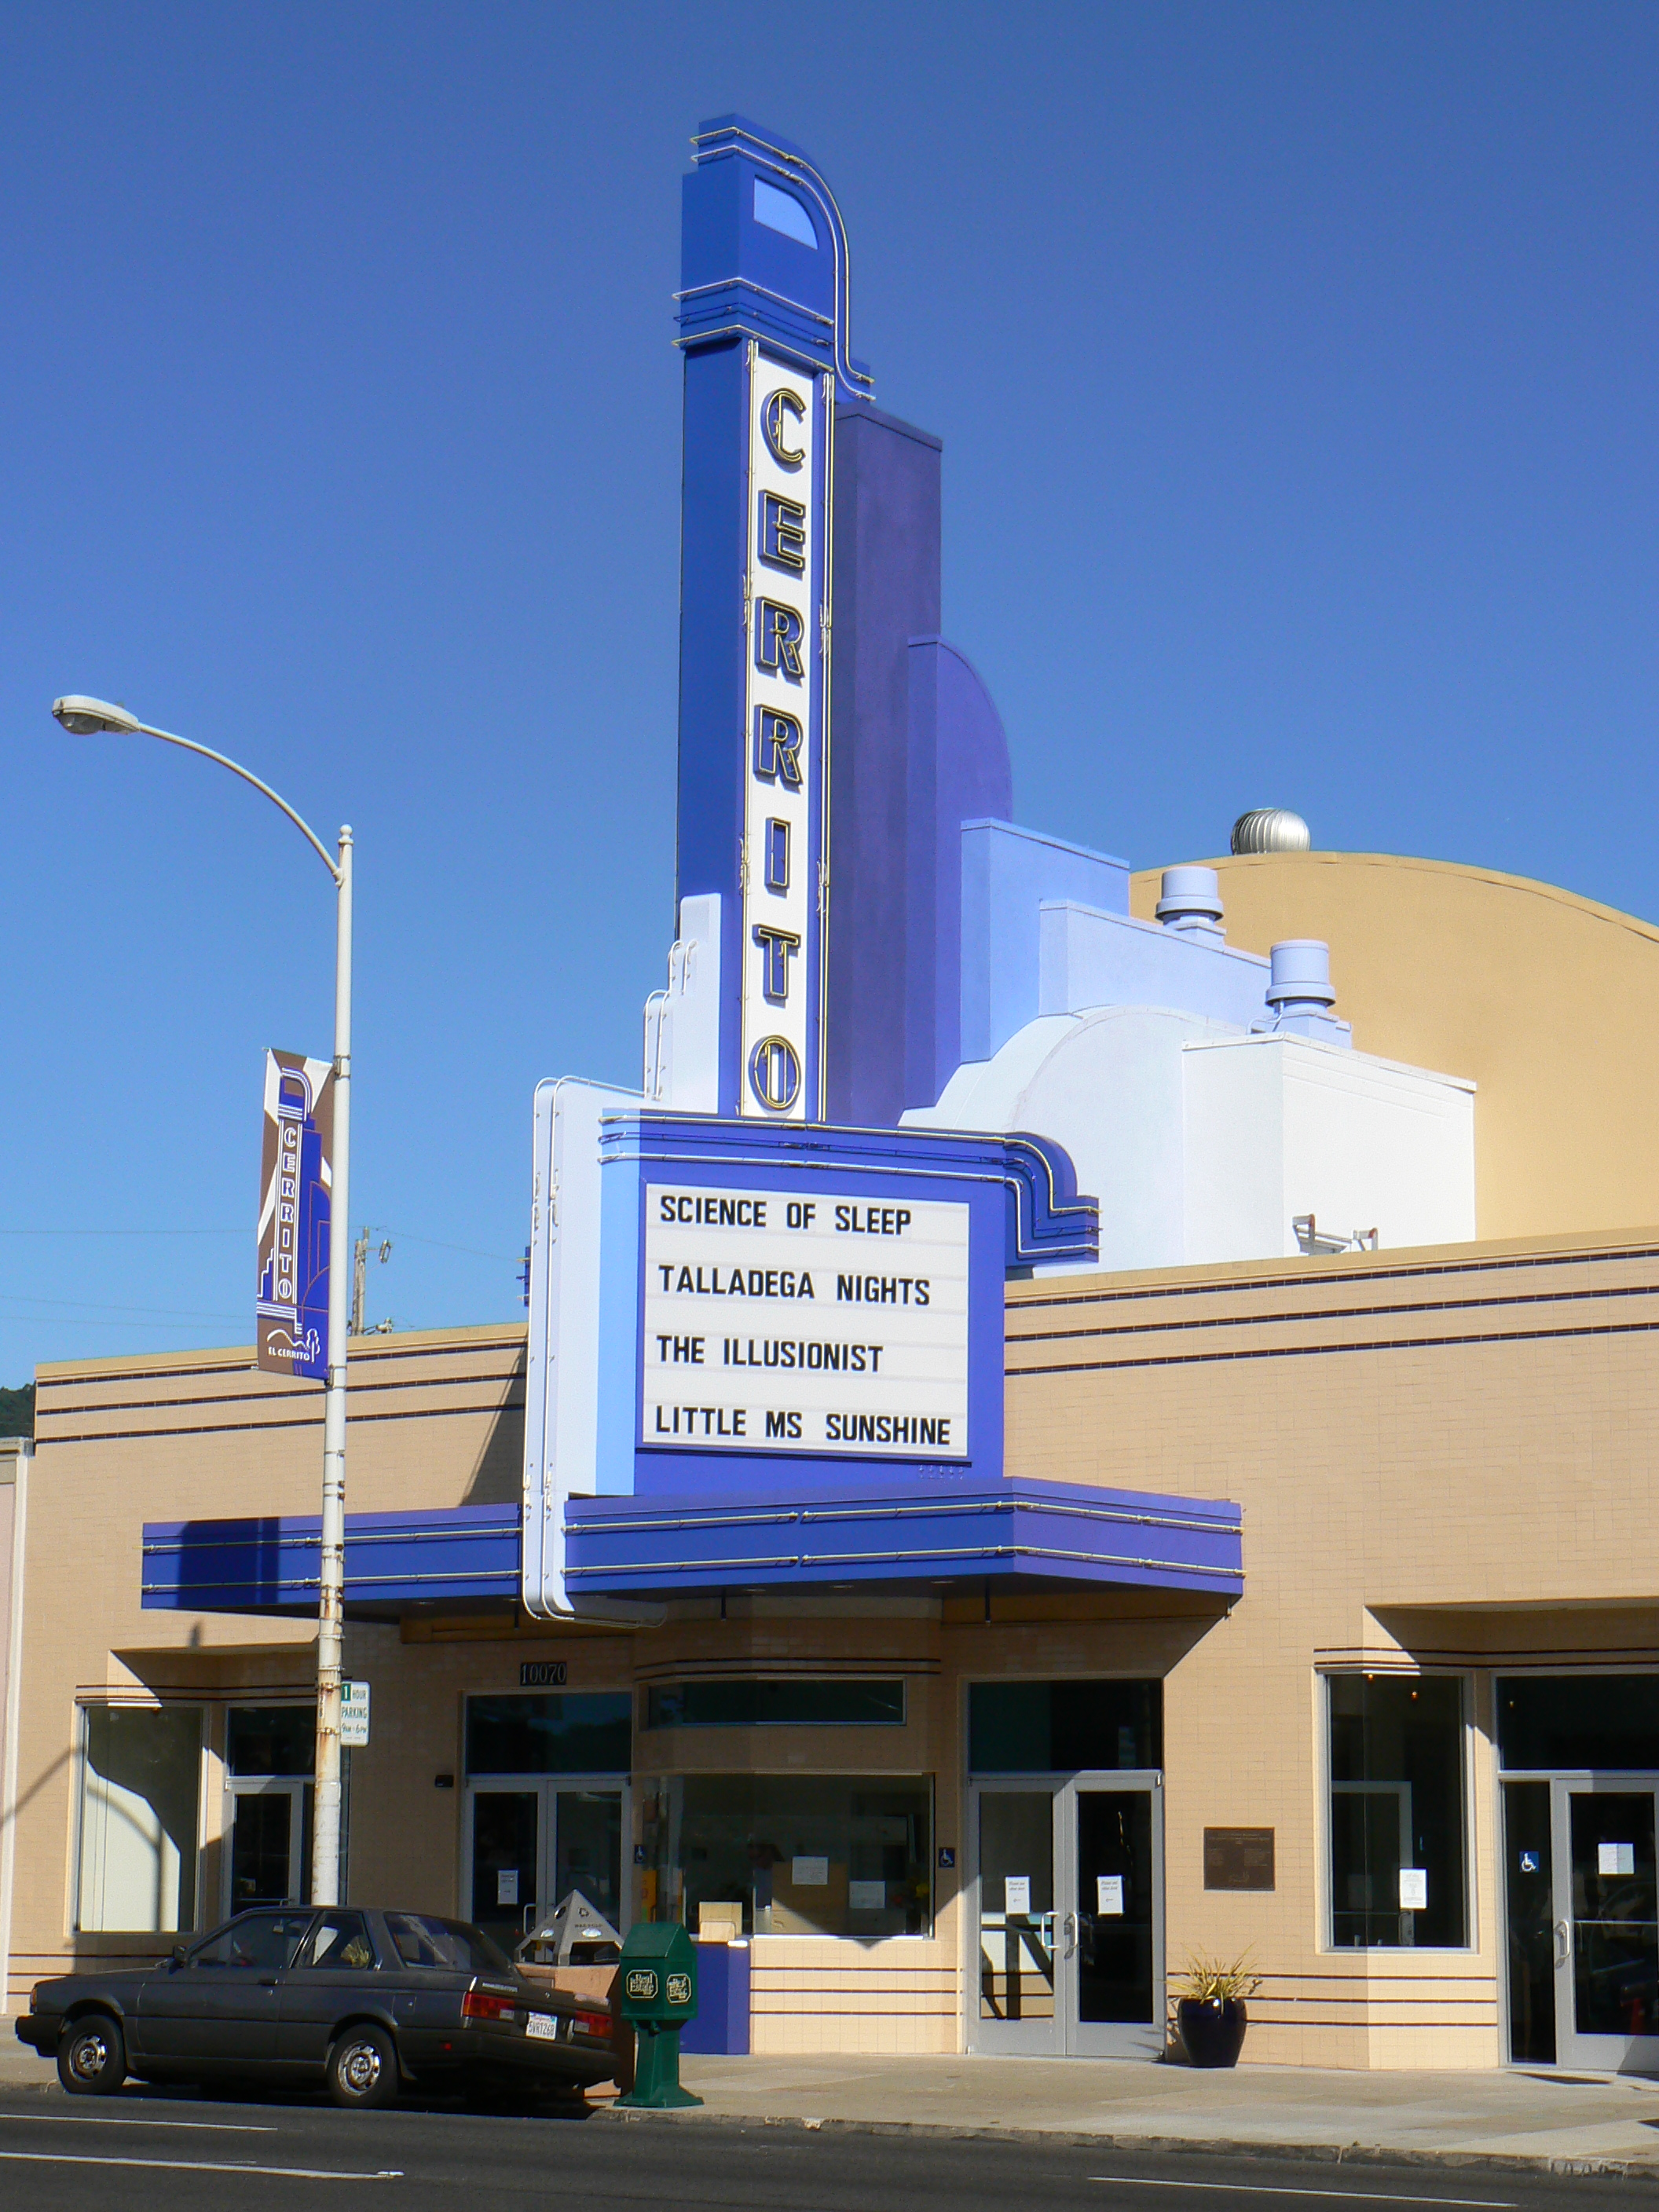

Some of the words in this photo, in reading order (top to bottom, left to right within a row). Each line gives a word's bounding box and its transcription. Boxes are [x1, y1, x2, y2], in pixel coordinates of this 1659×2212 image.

[749, 388, 807, 1110] CERRITO
[277, 1126, 298, 1300] CERRITO
[660, 1195, 767, 1227] SCIENCE
[786, 1202, 817, 1229] OF
[835, 1205, 911, 1236] SLEEP
[658, 1265, 815, 1299] TALLADEGA
[837, 1274, 931, 1306] NIGHTS
[268, 1346, 276, 1356] EL
[277, 1348, 310, 1361] CERRITO
[657, 1335, 705, 1364] THE
[723, 1338, 884, 1372] ILLUSIONIST
[656, 1405, 747, 1437] LITTLE
[765, 1411, 803, 1439] MS
[826, 1413, 951, 1445] SUNSHINE
[522, 1663, 566, 1684] 10070
[341, 1706, 368, 1719] PARKING
[352, 1689, 367, 1700] HOUR
